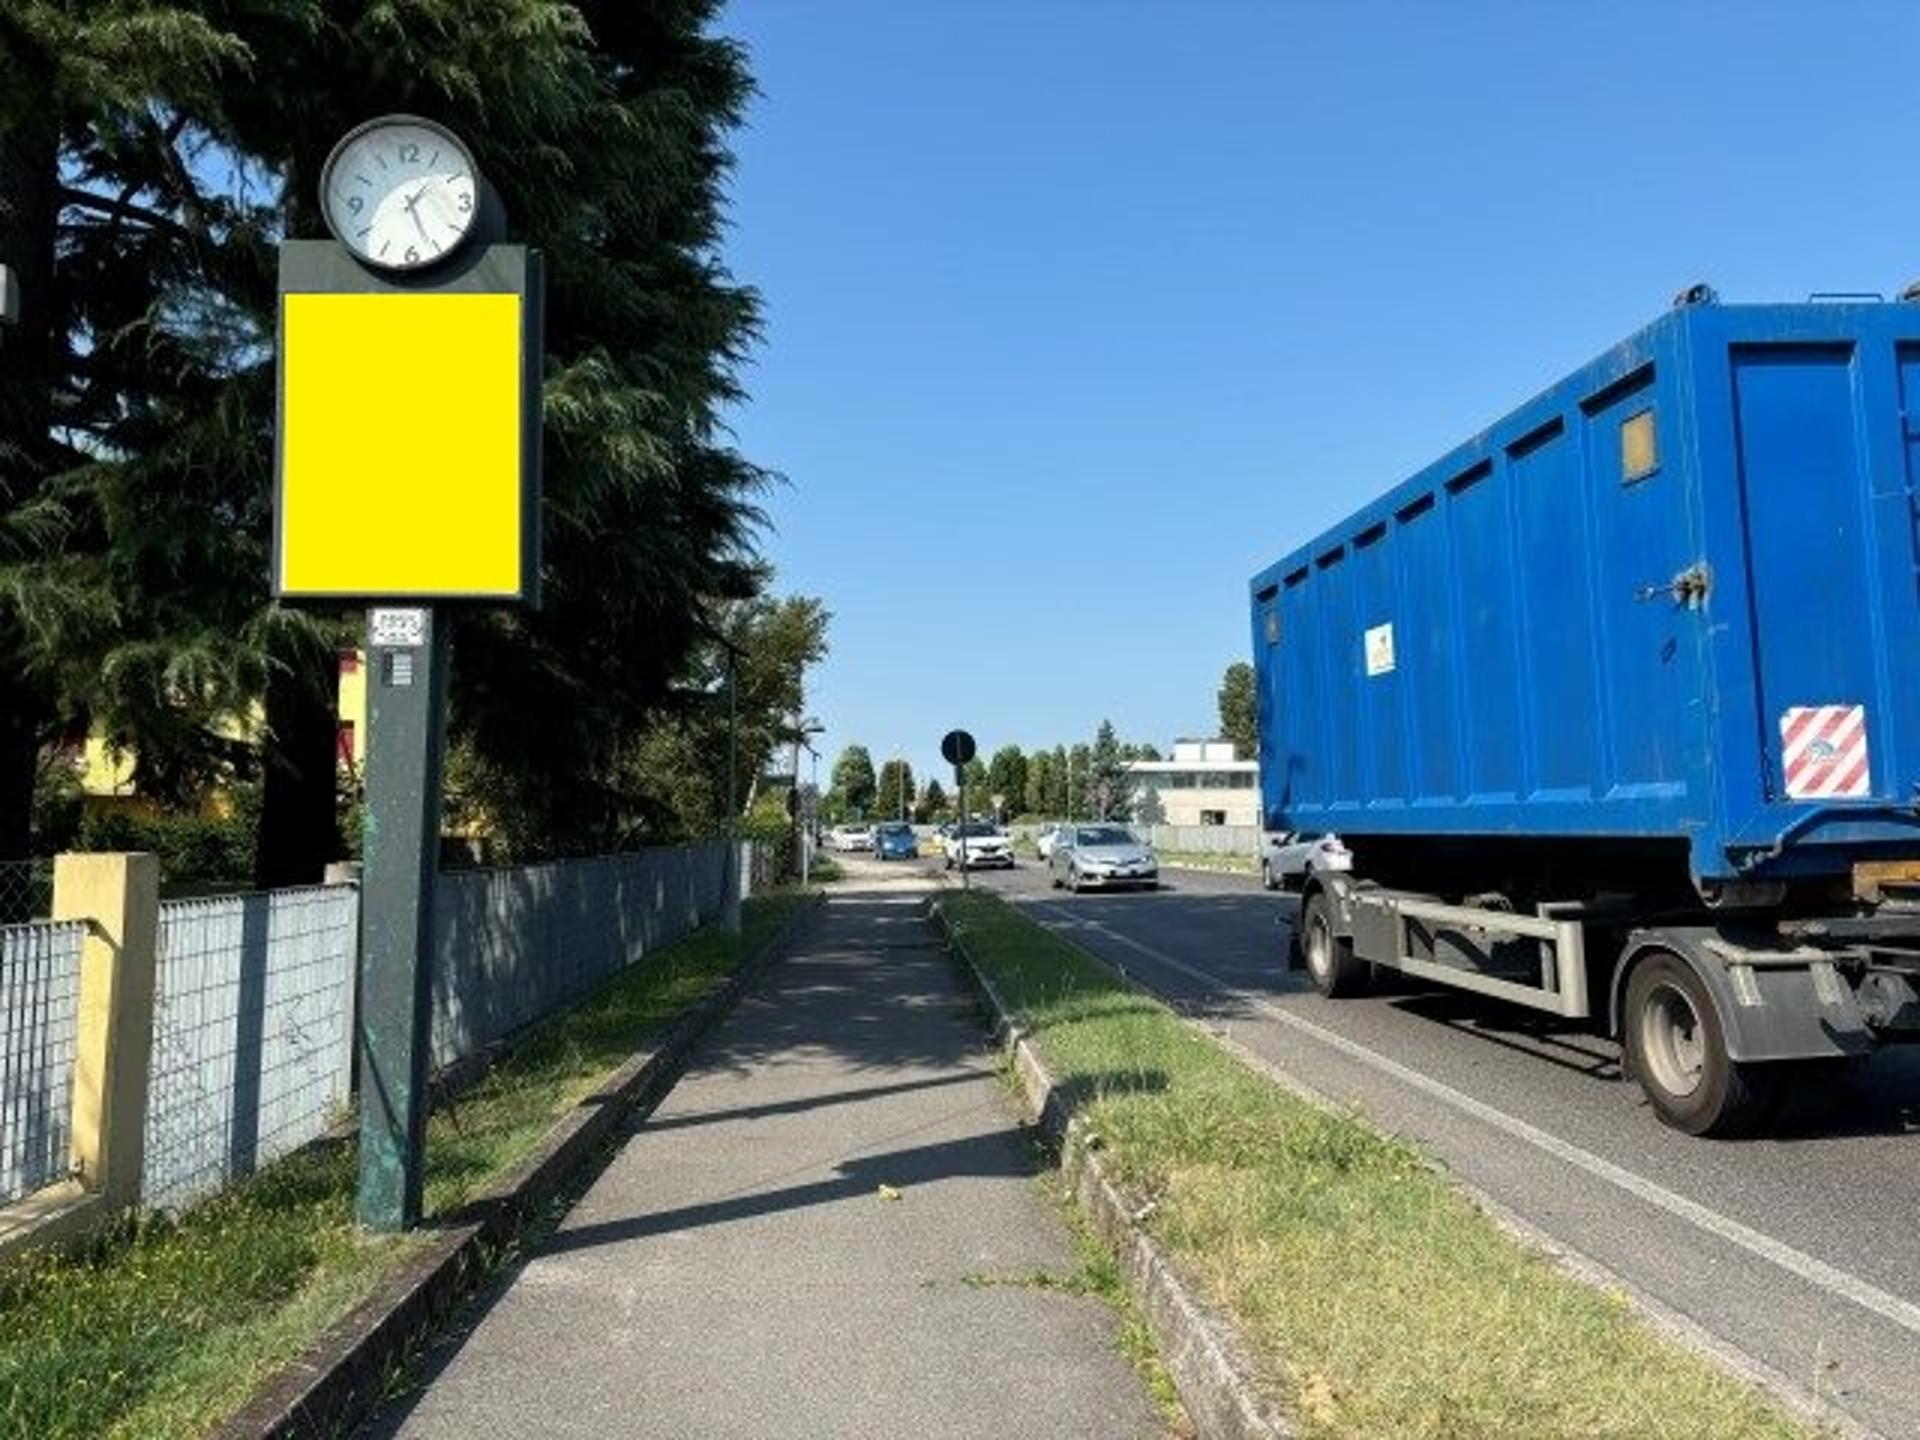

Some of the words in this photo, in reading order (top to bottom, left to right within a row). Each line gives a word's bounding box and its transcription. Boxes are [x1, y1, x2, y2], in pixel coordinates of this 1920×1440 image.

[399, 143, 420, 163] 12
[348, 196, 364, 216] 9
[458, 192, 472, 213] 3
[404, 246, 420, 264] 6
